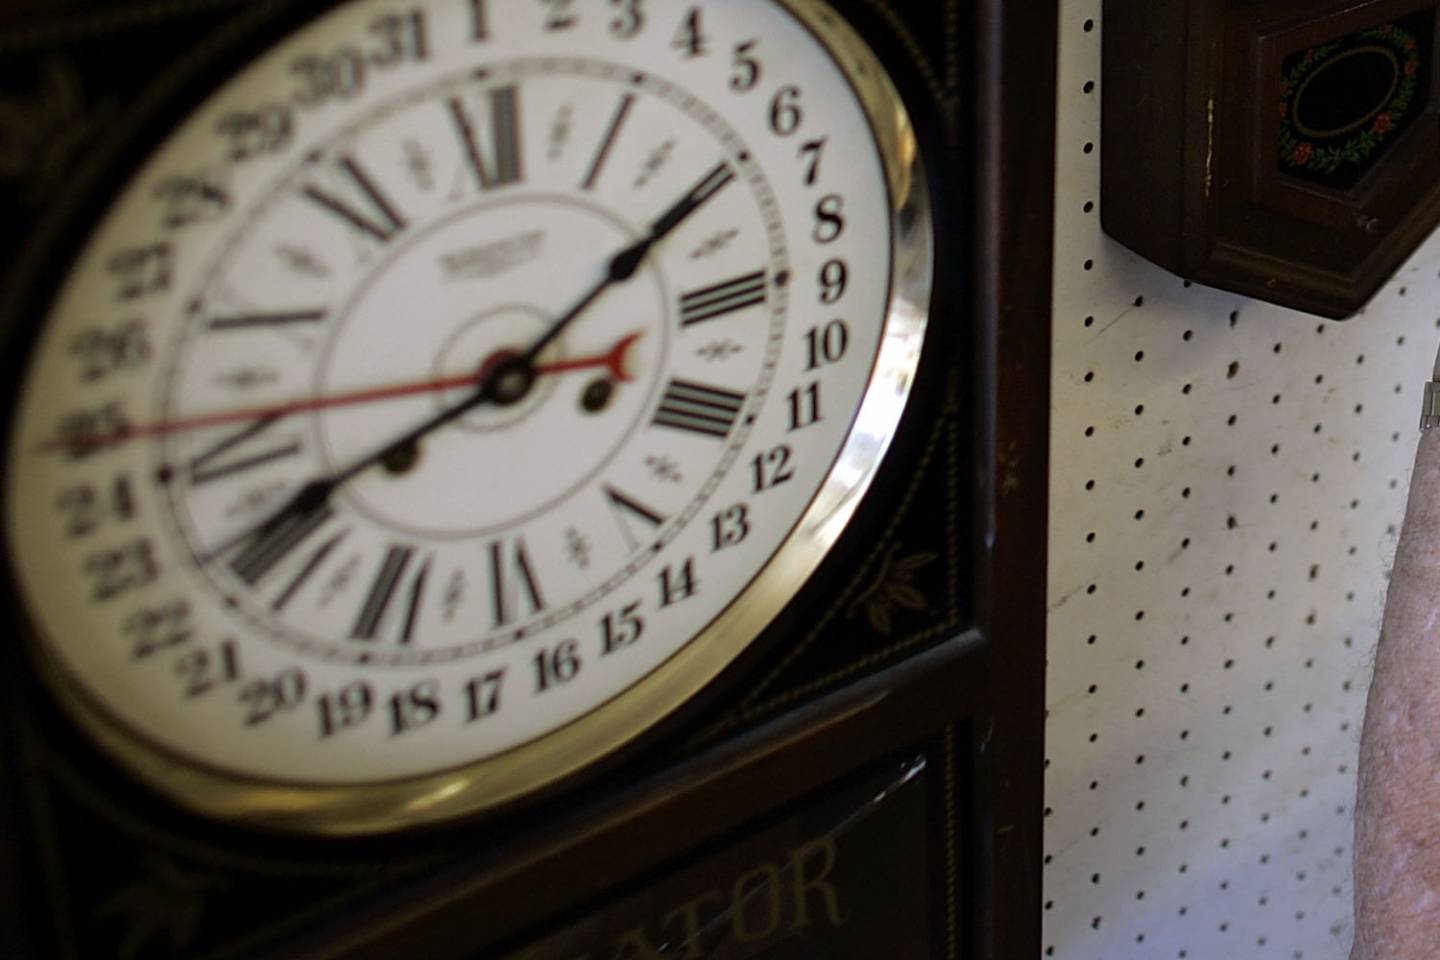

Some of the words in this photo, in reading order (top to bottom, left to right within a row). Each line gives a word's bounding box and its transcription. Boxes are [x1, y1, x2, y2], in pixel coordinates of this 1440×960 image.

[671, 4, 708, 60] 4
[729, 38, 763, 93] 5
[767, 85, 803, 137] 6
[797, 134, 829, 187] 7
[812, 192, 844, 245] 8
[678, 268, 768, 329] III
[817, 257, 849, 305] 9
[805, 318, 850, 372] 10
[651, 376, 748, 440] IIII
[786, 380, 824, 432] 11
[748, 442, 796, 496] 12
[709, 501, 752, 553] 13
[655, 554, 701, 609] 14
[597, 597, 645, 657] 15
[534, 640, 582, 696] 16
[316, 680, 374, 737] 19
[387, 678, 441, 737] 18
[463, 668, 508, 724] 17
